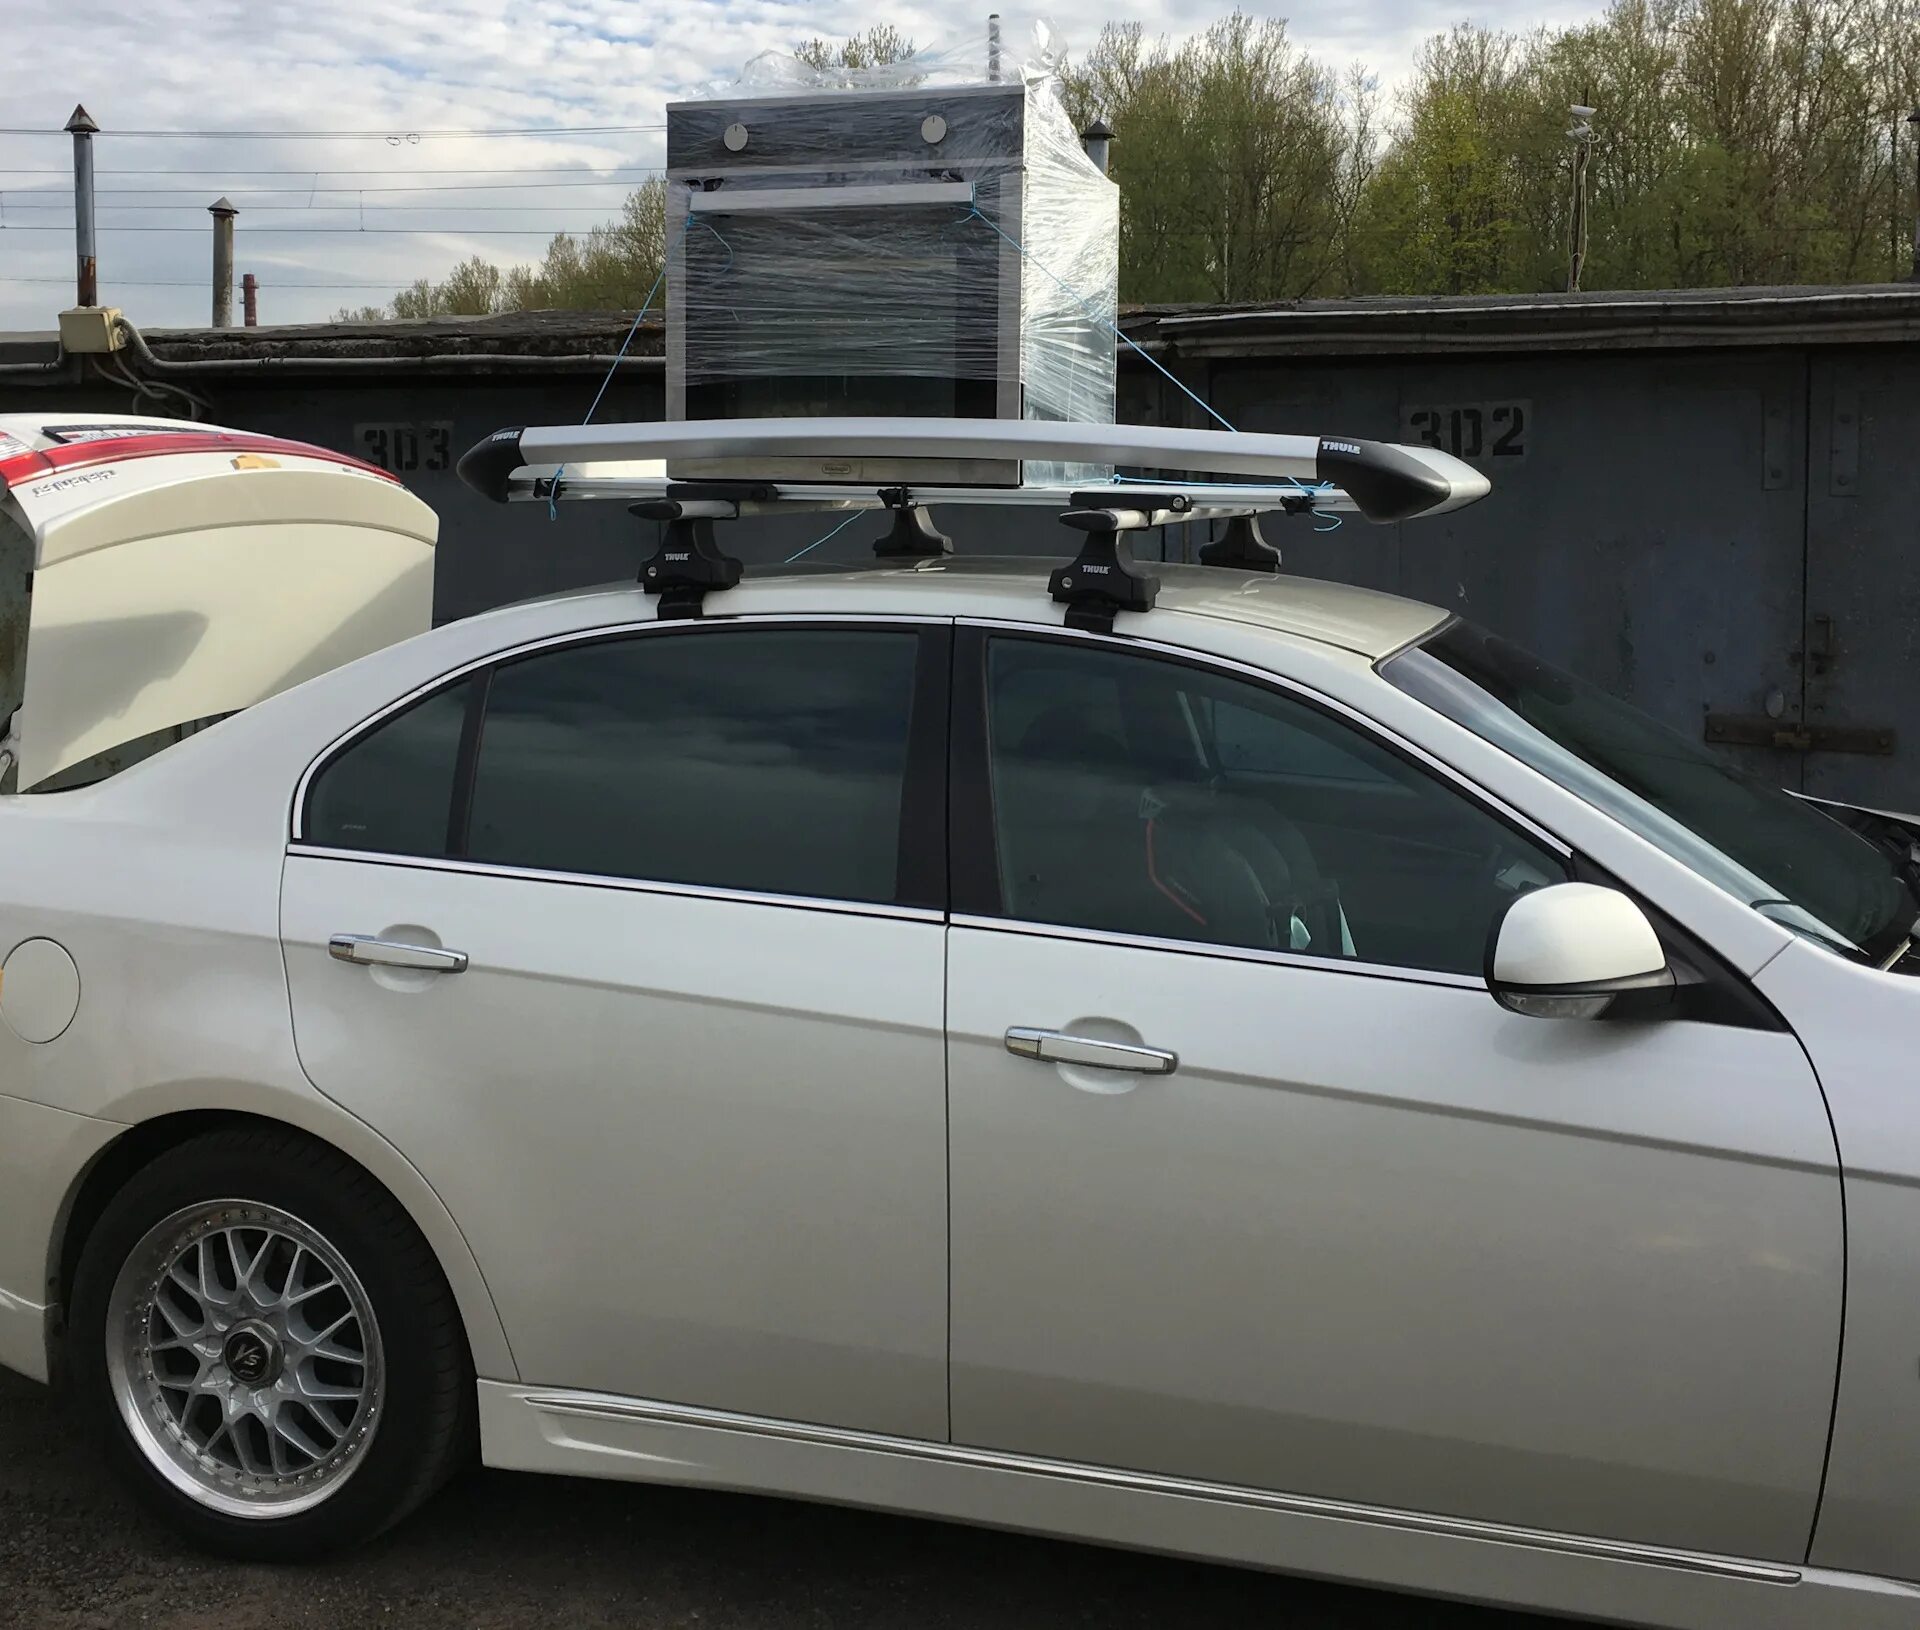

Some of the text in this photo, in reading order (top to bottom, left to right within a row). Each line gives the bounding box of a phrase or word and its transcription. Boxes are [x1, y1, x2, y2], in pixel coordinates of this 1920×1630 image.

[492, 430, 520, 442] THULE
[1410, 407, 1524, 458] 302
[364, 428, 450, 471] 303
[1321, 441, 1361, 454] THULE
[665, 553, 691, 561] THULE
[1082, 565, 1111, 574] THULE
